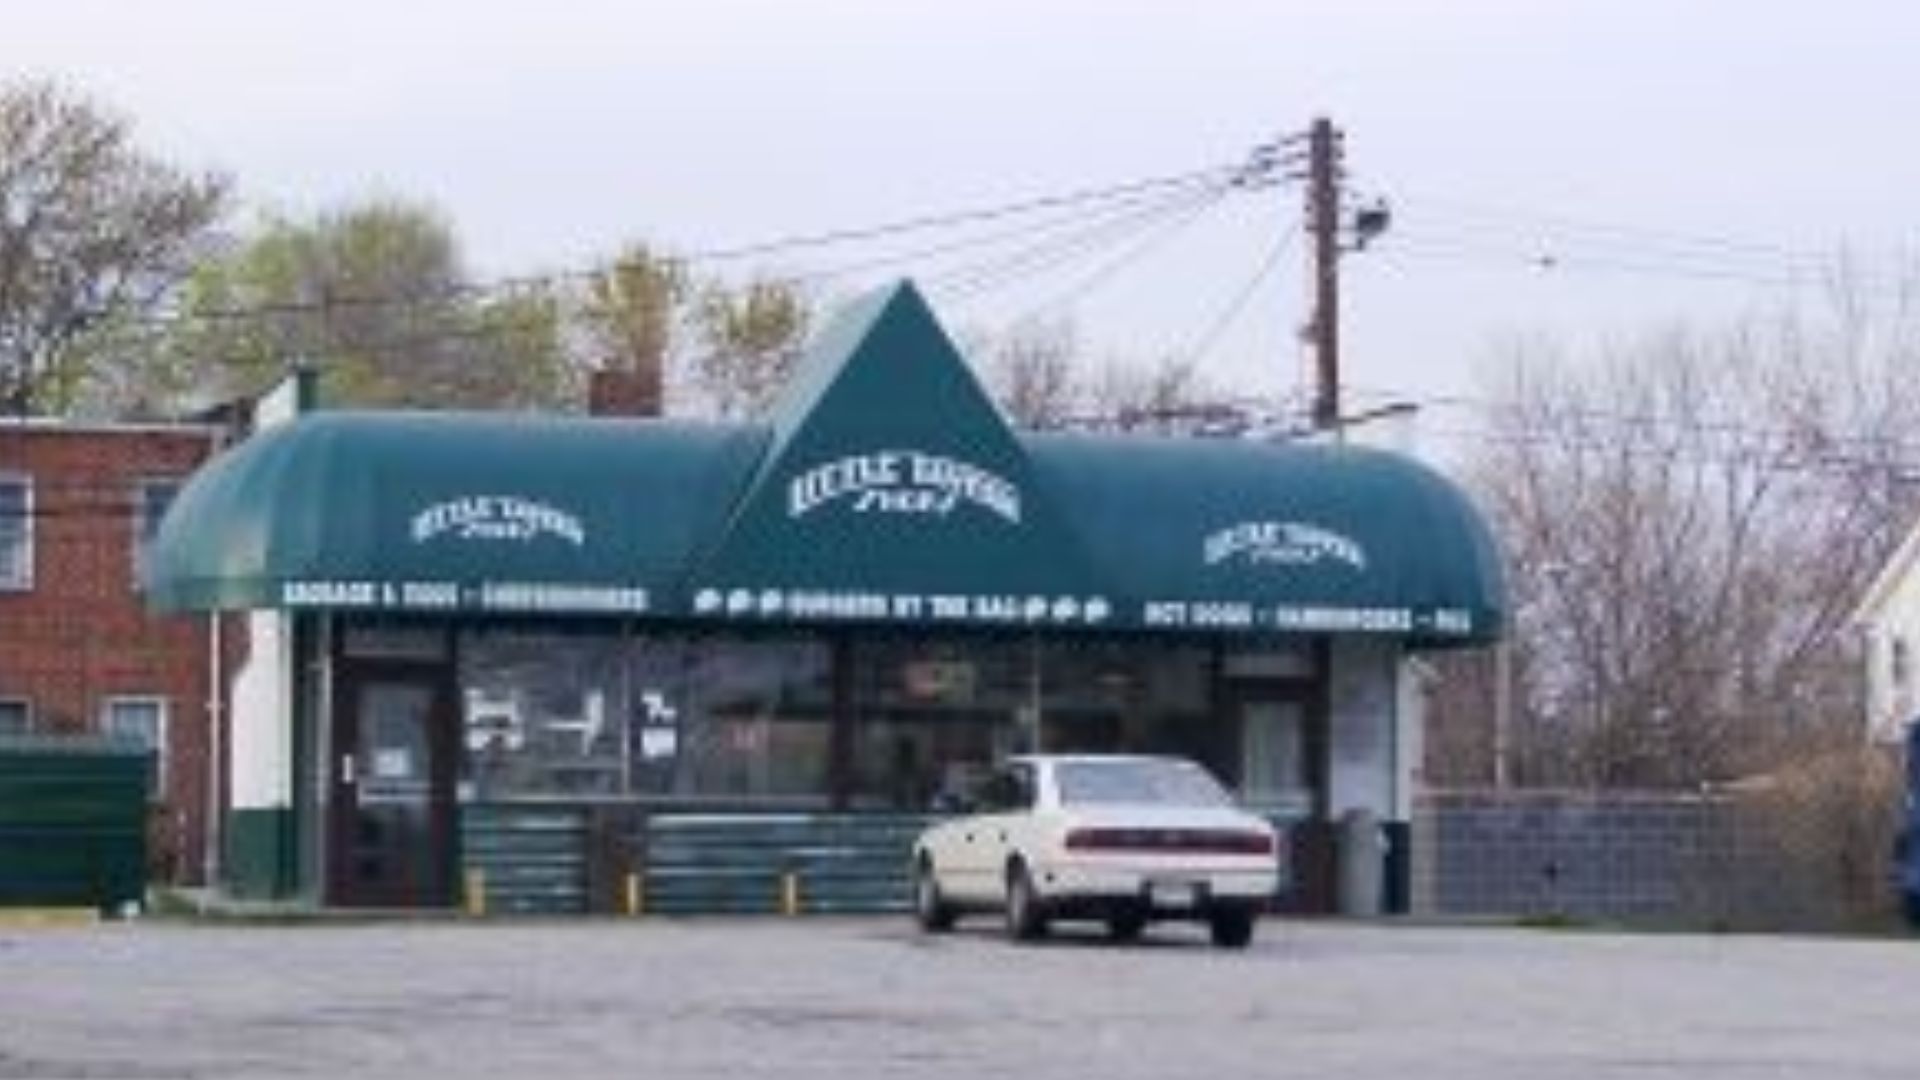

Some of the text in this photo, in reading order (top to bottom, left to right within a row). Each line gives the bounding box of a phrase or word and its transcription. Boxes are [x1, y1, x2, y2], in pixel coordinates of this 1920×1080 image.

[786, 452, 899, 518] LITTLE
[409, 495, 493, 544] LITTLE
[1143, 602, 1187, 626] HOT
